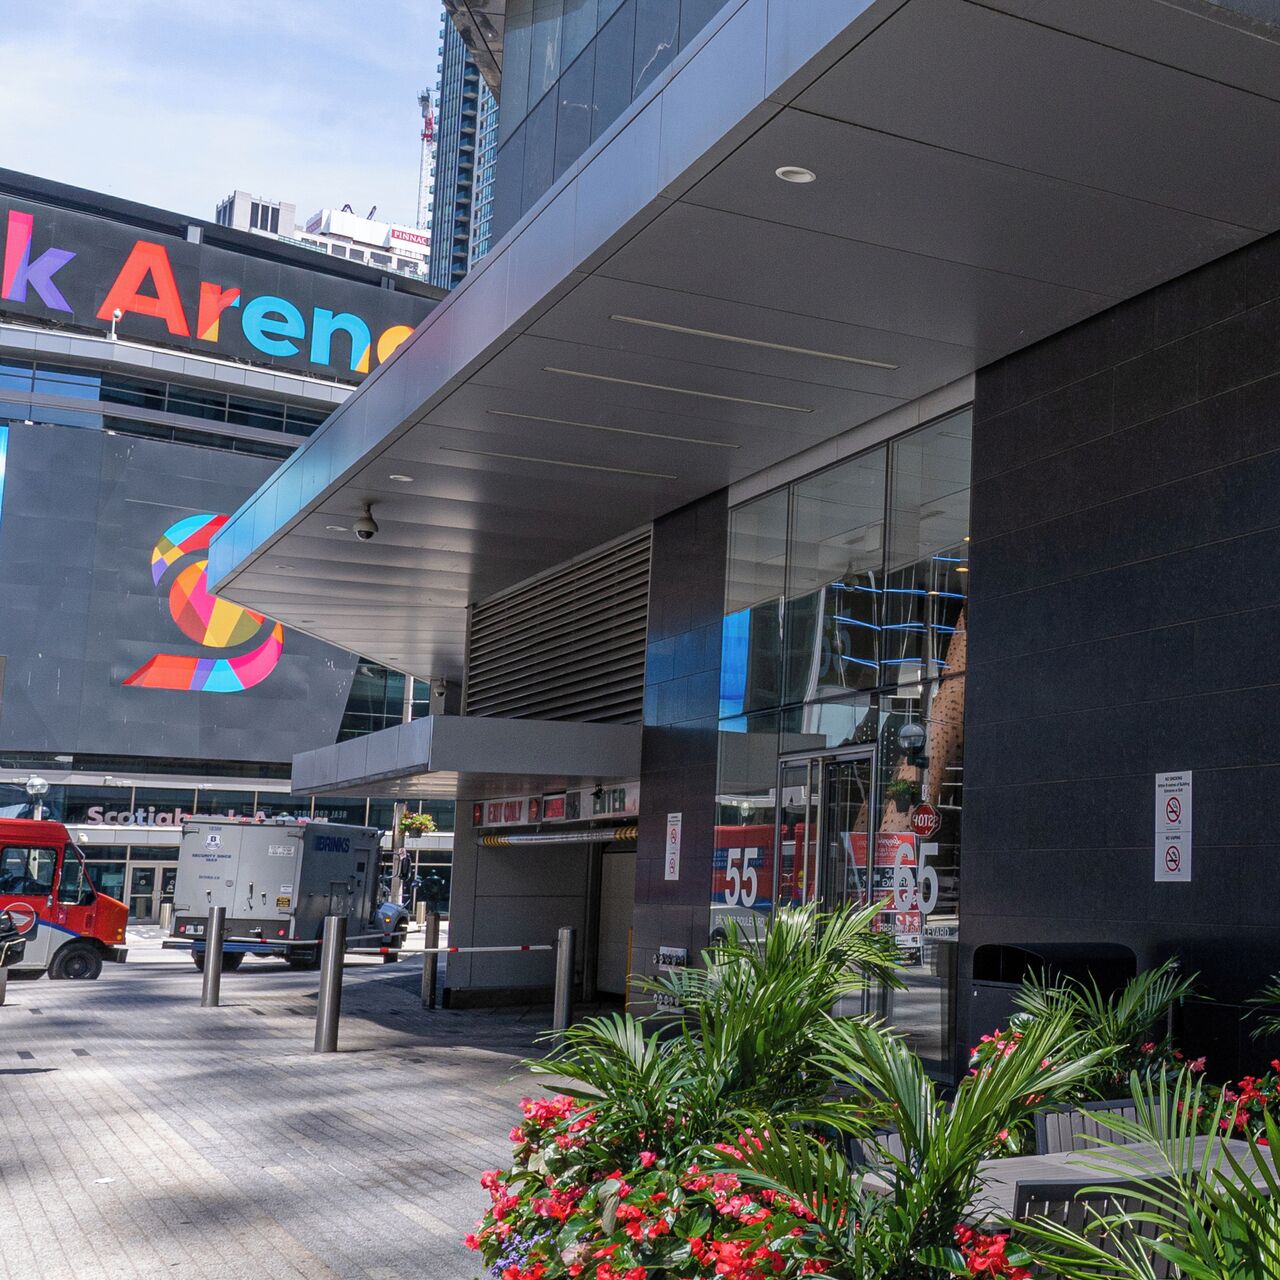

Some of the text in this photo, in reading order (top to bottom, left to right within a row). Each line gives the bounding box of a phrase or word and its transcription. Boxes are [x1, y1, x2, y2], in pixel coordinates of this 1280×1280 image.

[487, 802, 502, 824] EXIT
[503, 799, 523, 823] ONLY
[317, 835, 351, 853] BRINKS
[724, 847, 758, 908] 55
[894, 842, 939, 914] 65
